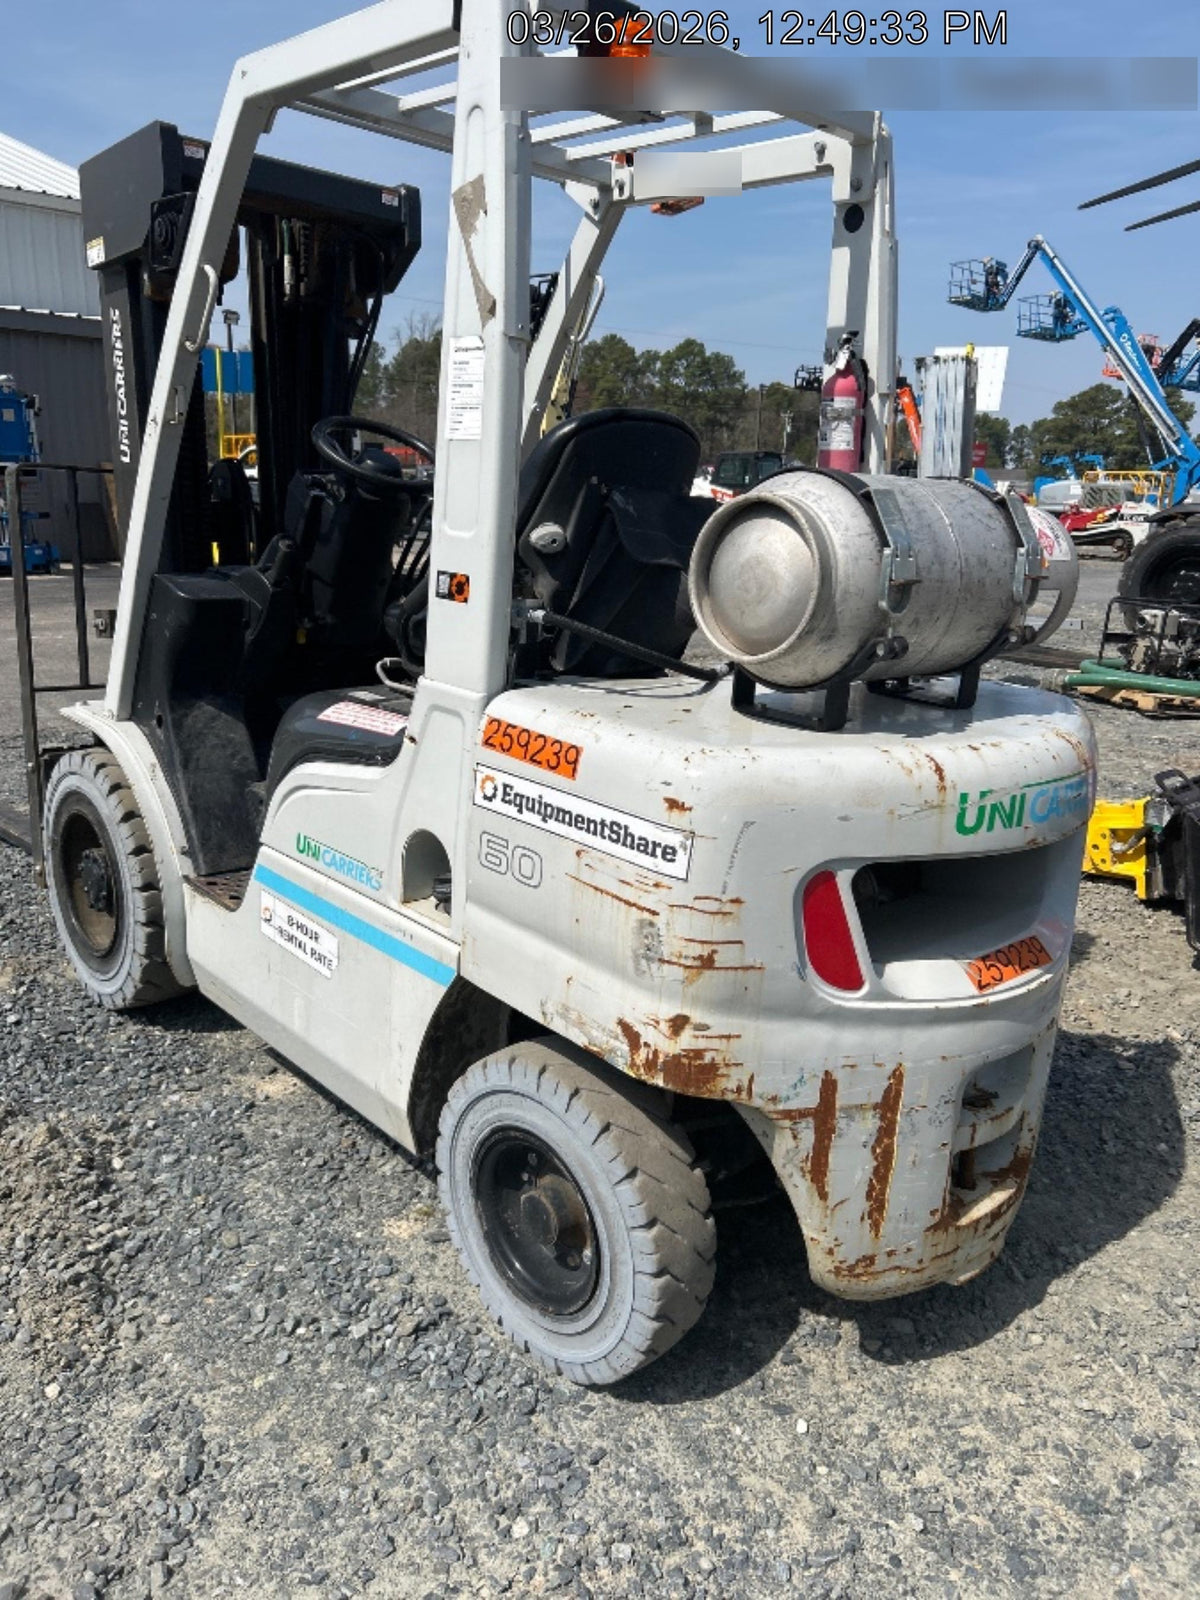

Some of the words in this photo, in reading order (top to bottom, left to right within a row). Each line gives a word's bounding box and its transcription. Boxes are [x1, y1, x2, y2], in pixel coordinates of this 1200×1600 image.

[484, 718, 581, 778] 259239
[501, 782, 678, 863] EquipmentShare
[478, 830, 543, 889] 60
